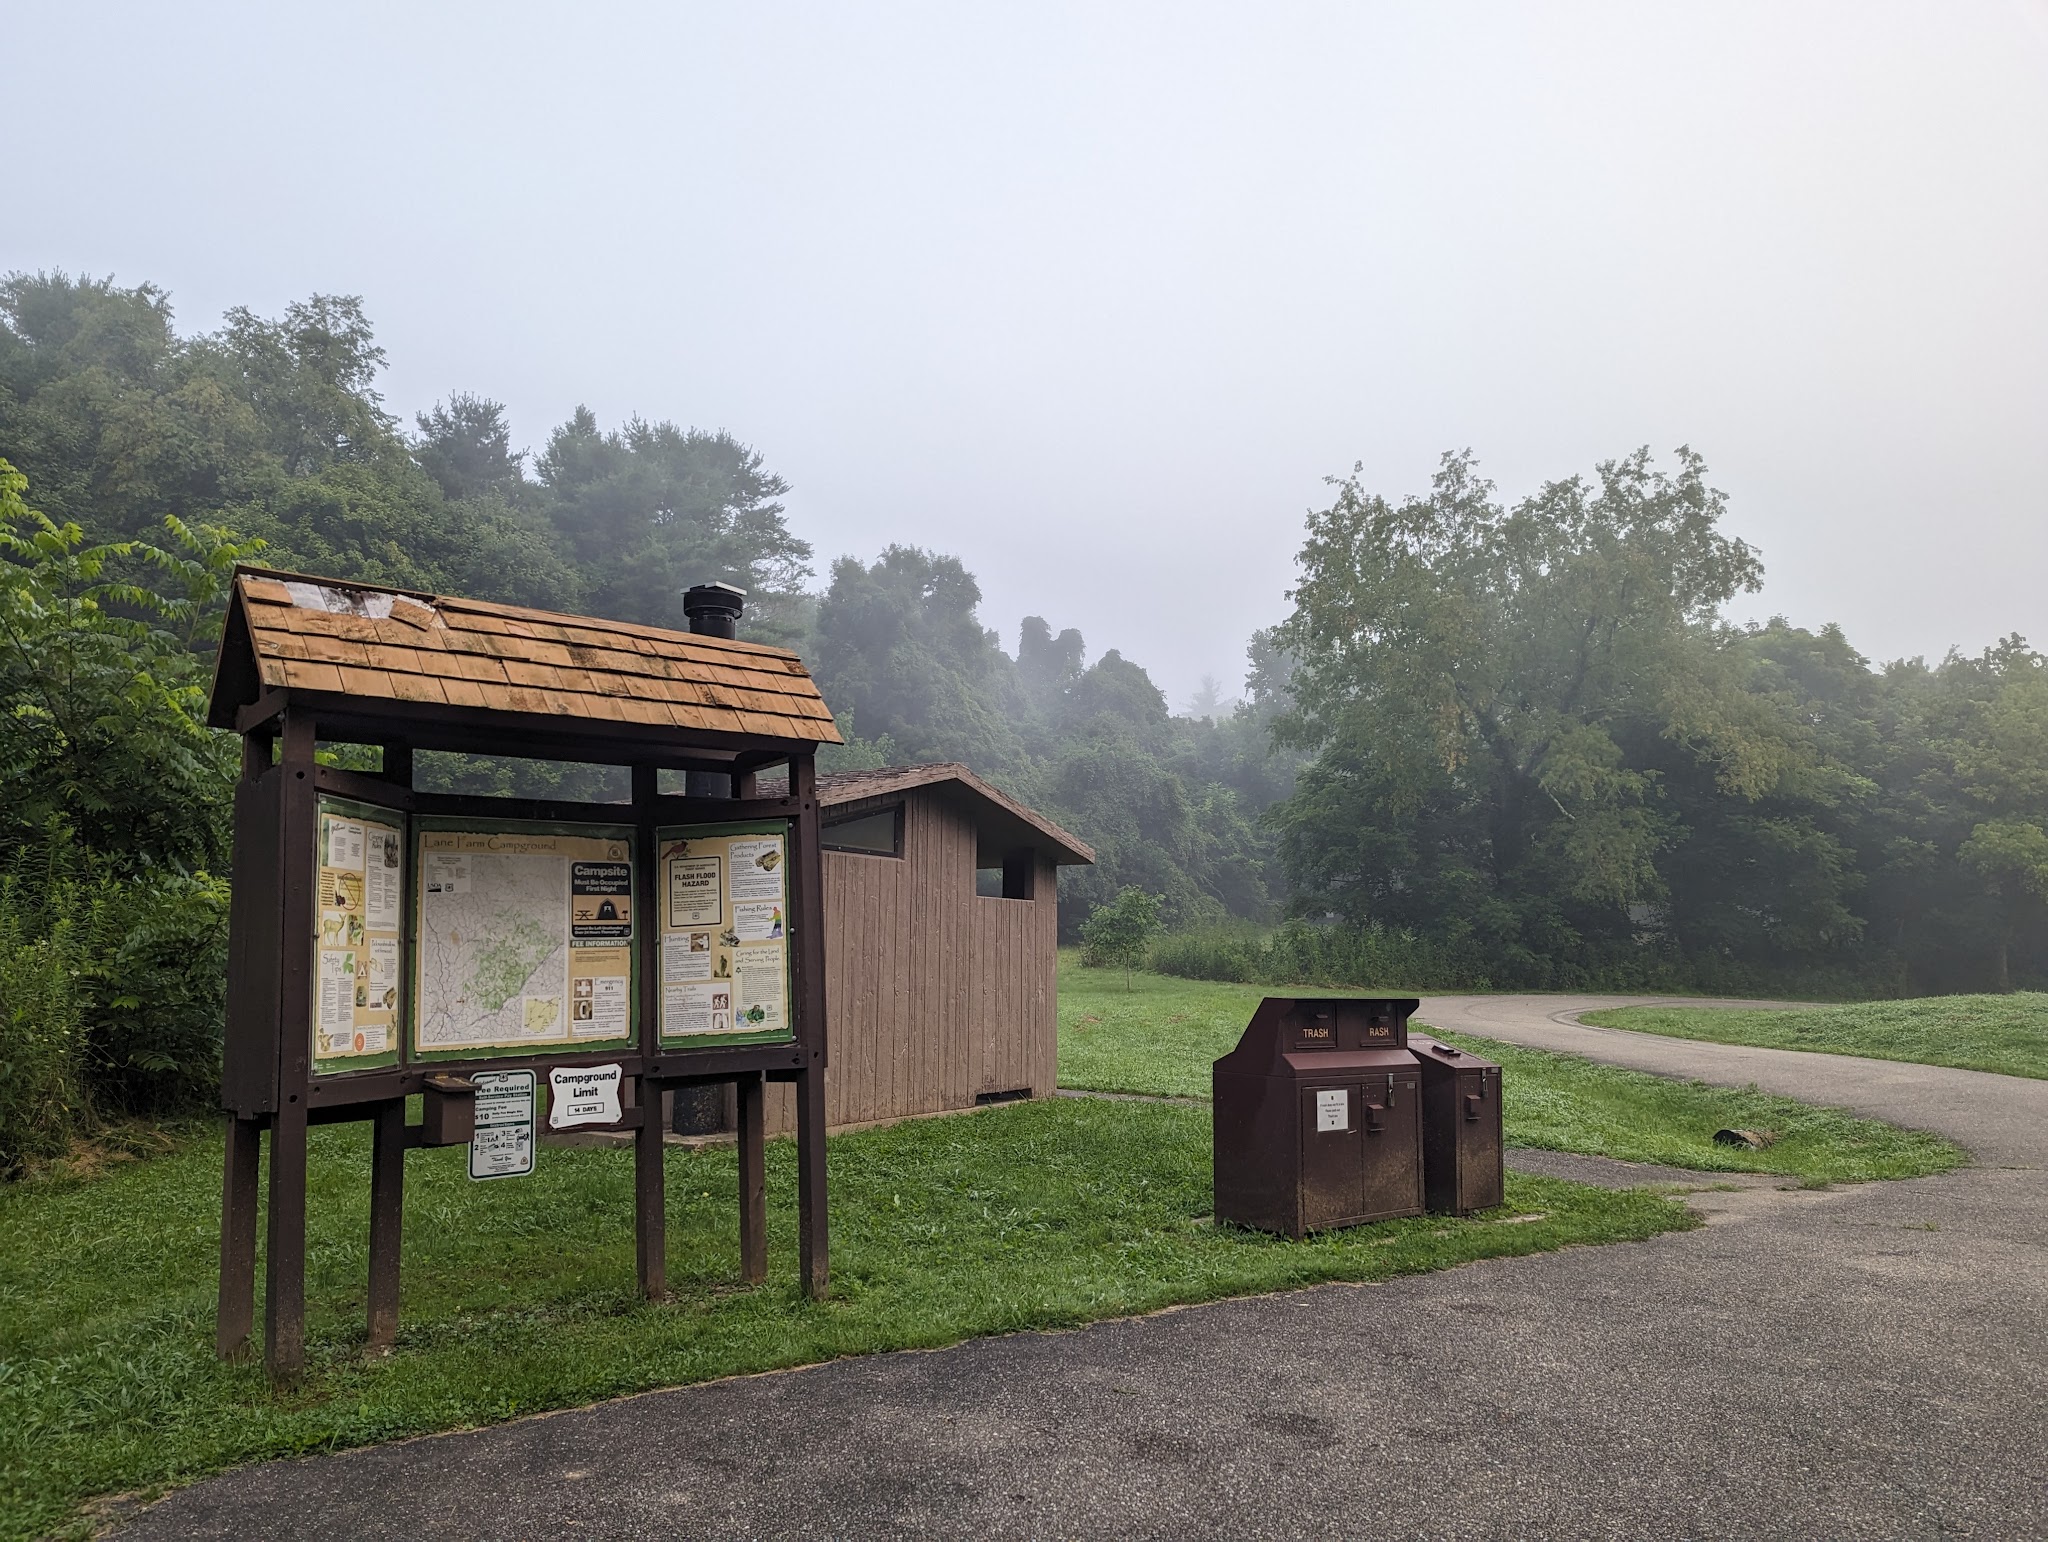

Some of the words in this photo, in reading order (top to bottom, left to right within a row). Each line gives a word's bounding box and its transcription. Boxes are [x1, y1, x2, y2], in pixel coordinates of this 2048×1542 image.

[424, 835, 453, 848] Lane
[457, 836, 484, 848] Farm
[488, 836, 556, 853] Campground
[731, 844, 758, 852] Gathering
[574, 866, 628, 878] Campsite
[322, 953, 339, 966] Safety
[331, 963, 341, 975] Tips
[595, 978, 623, 986] Emergency
[1303, 1028, 1329, 1038] TRASH
[1369, 1027, 1389, 1036] RASH
[555, 1070, 616, 1084] Campground
[494, 1084, 529, 1092] Required
[573, 1087, 598, 1097] Limit
